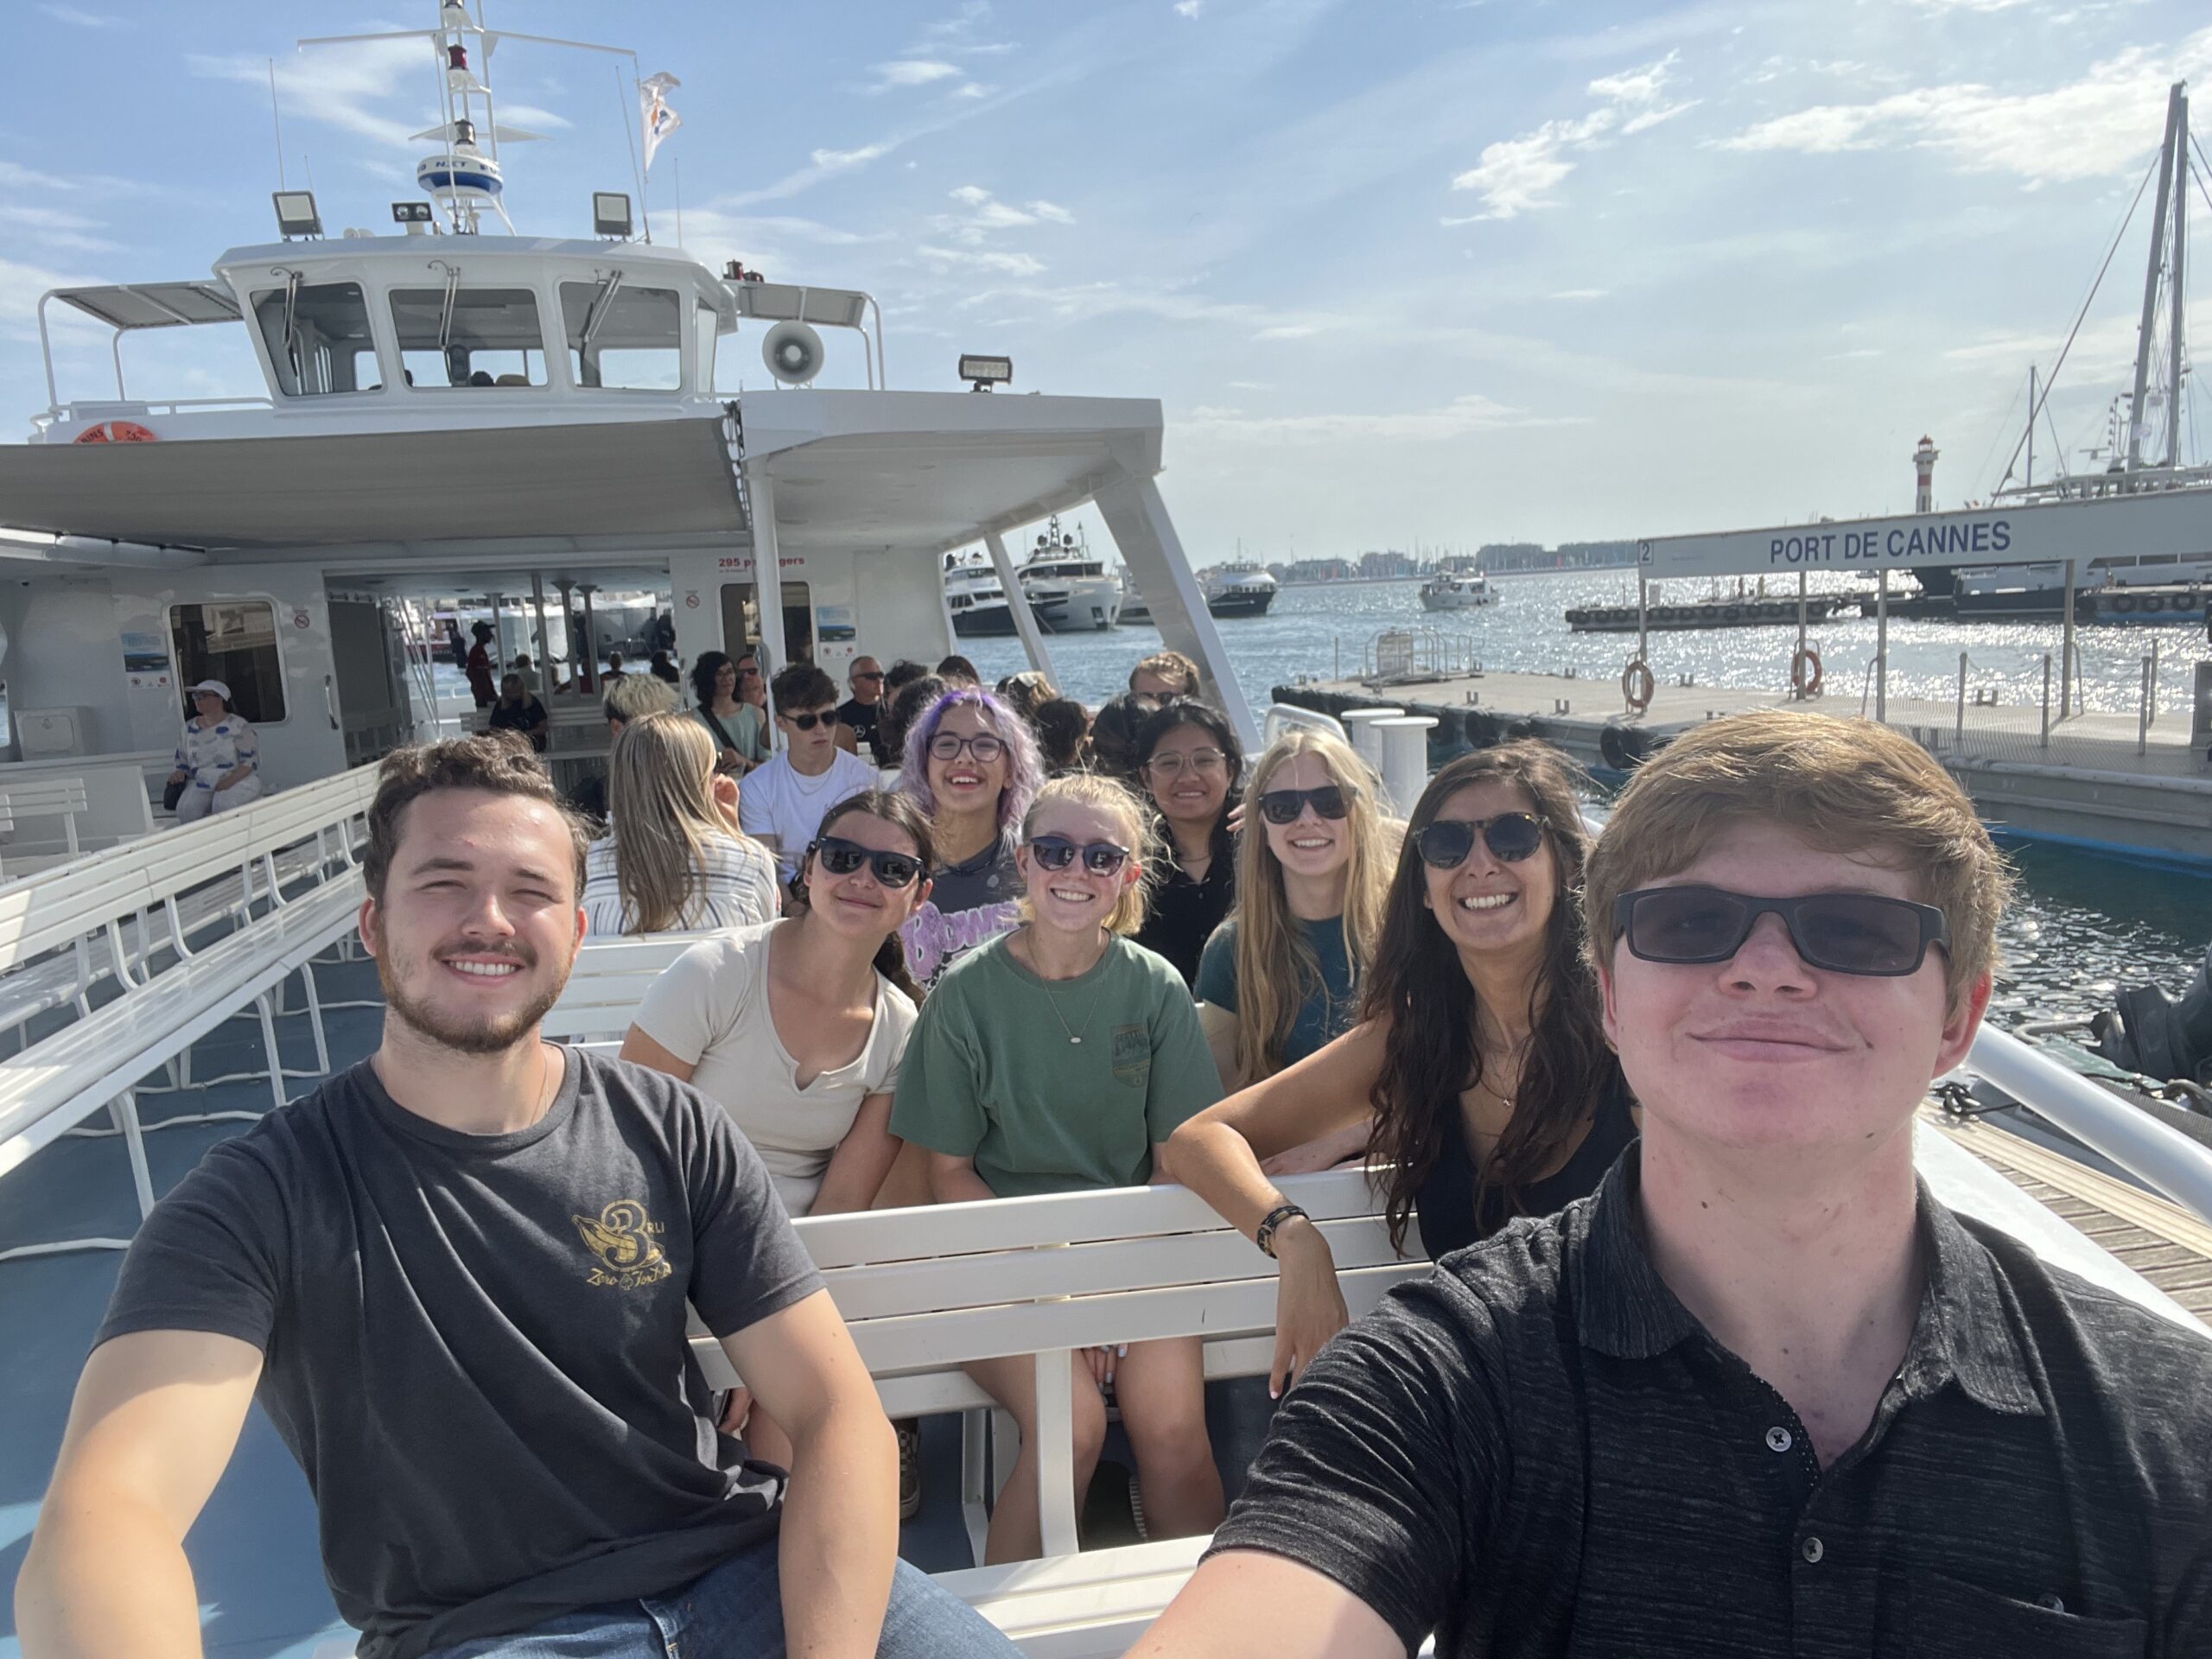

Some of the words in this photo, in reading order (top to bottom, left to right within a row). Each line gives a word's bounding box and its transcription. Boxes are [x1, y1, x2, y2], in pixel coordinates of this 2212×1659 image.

[1770, 534, 1836, 563] PORT
[1844, 531, 1878, 560] DE
[1886, 520, 2012, 557] CANNES
[1642, 543, 1650, 562] 2
[719, 557, 741, 568] 295
